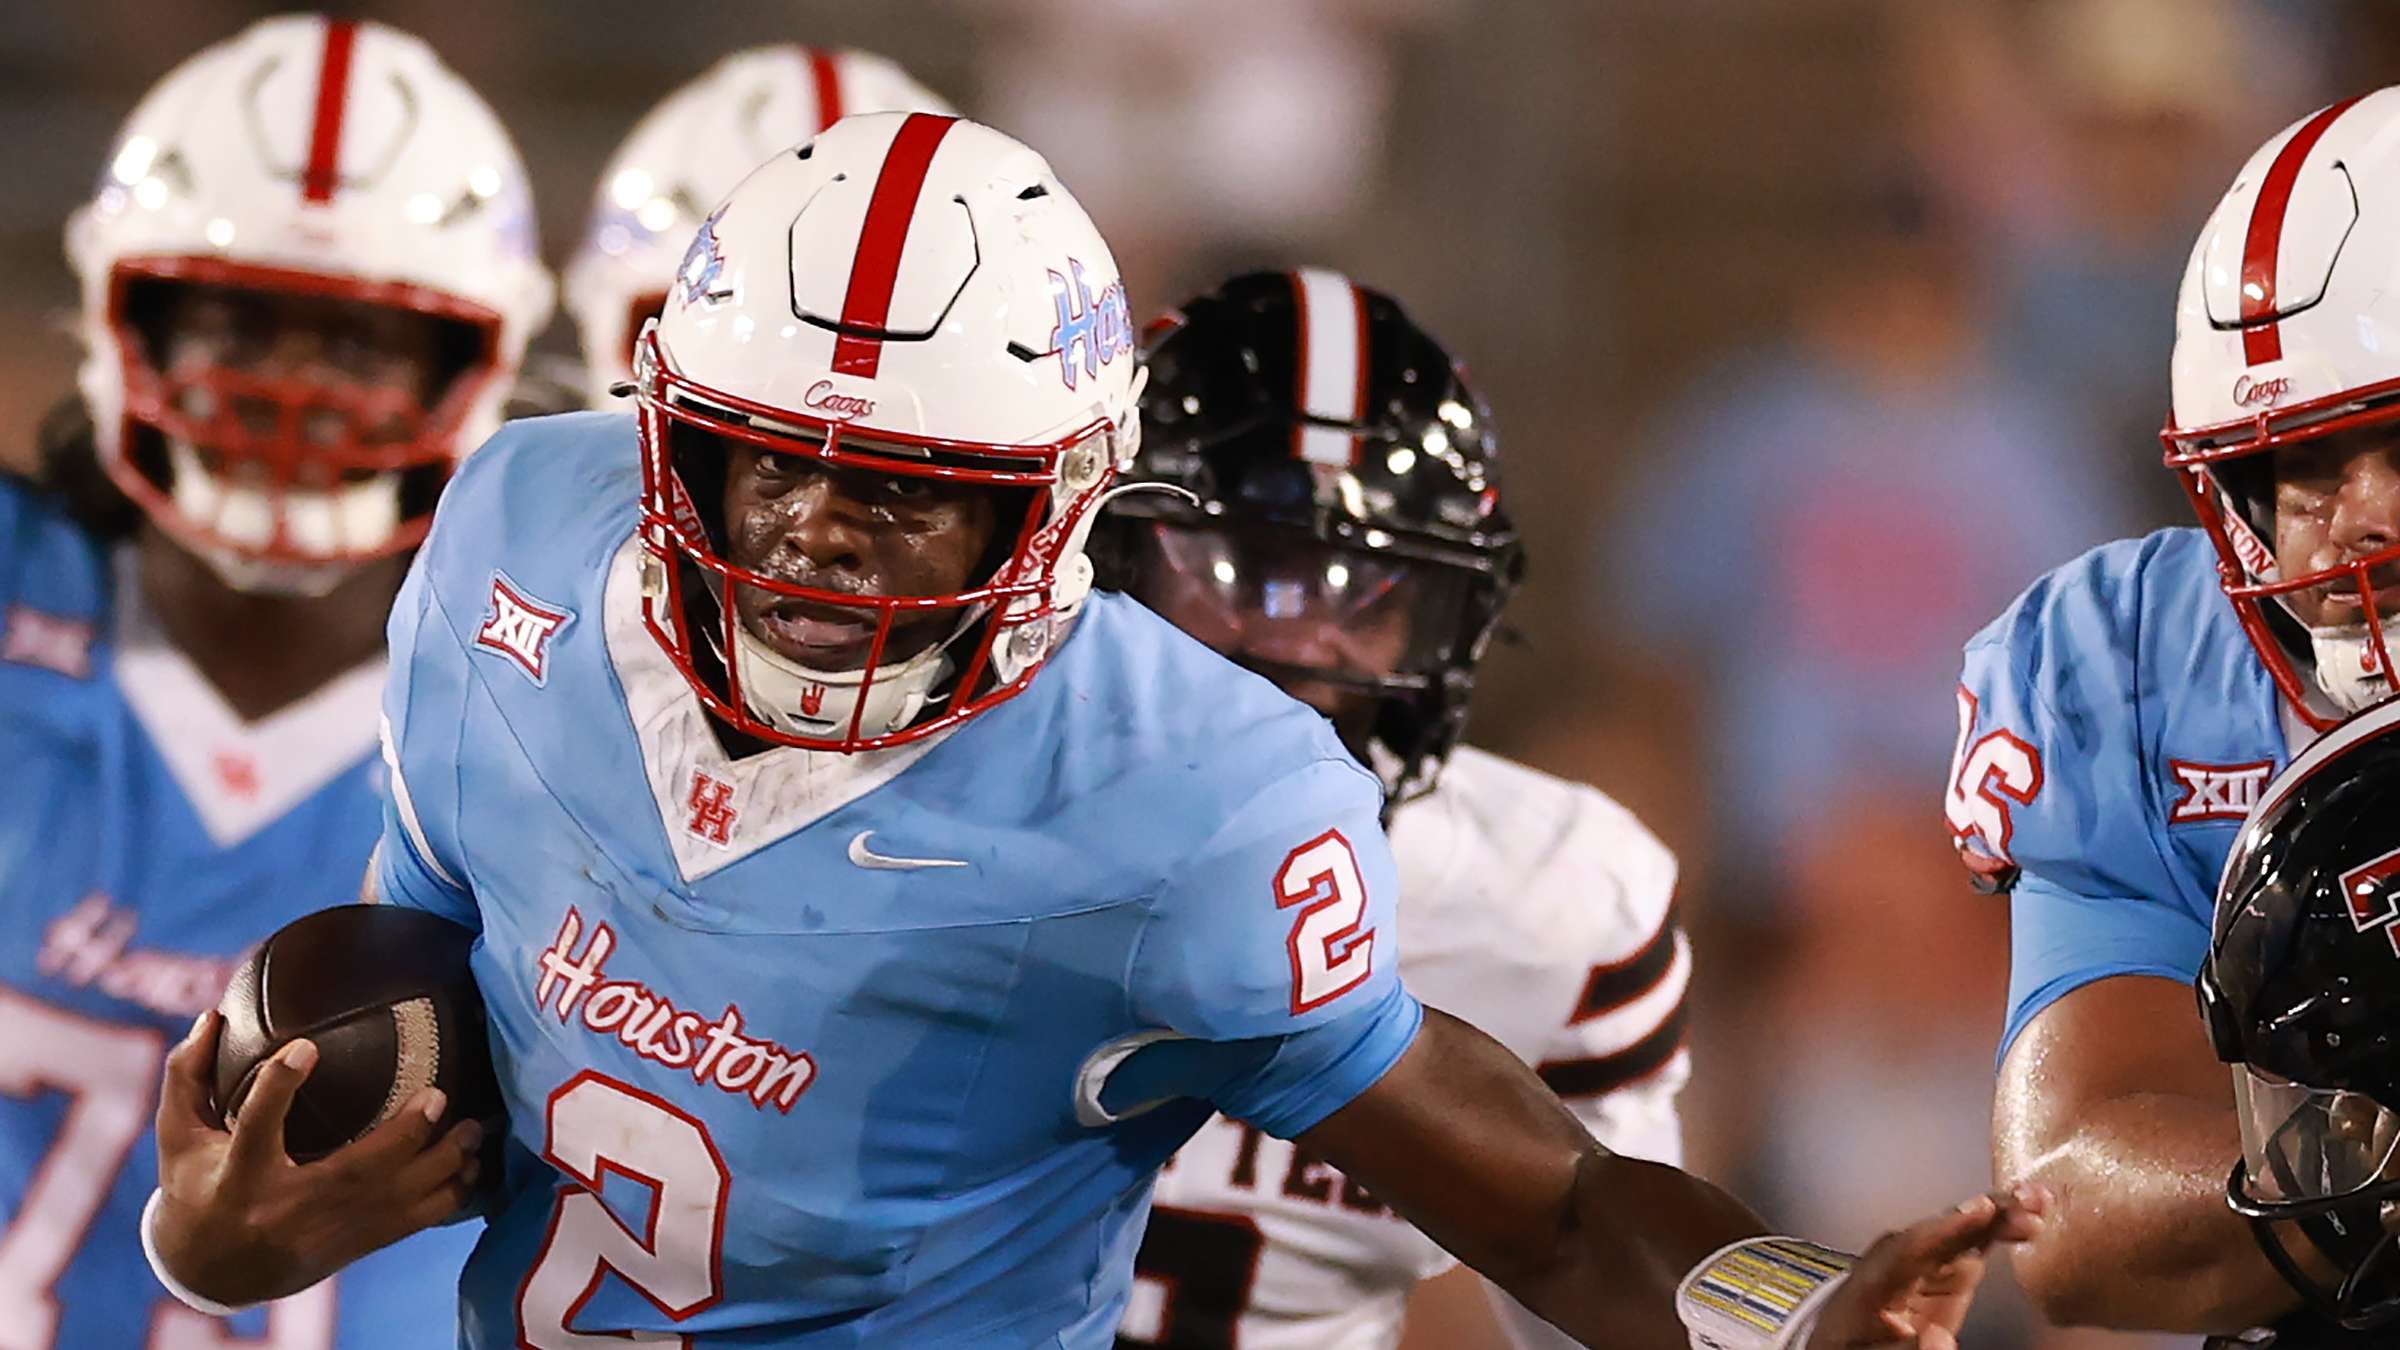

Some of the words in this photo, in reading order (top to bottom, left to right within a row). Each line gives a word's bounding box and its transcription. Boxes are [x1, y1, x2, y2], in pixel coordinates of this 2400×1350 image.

[804, 379, 876, 420] Coogs
[2233, 374, 2289, 407] Coogs
[481, 586, 559, 670] XII
[2172, 764, 2273, 822] XII
[1273, 827, 1375, 1016] 2
[535, 903, 818, 1116] Houston
[515, 1067, 732, 1350] 2
